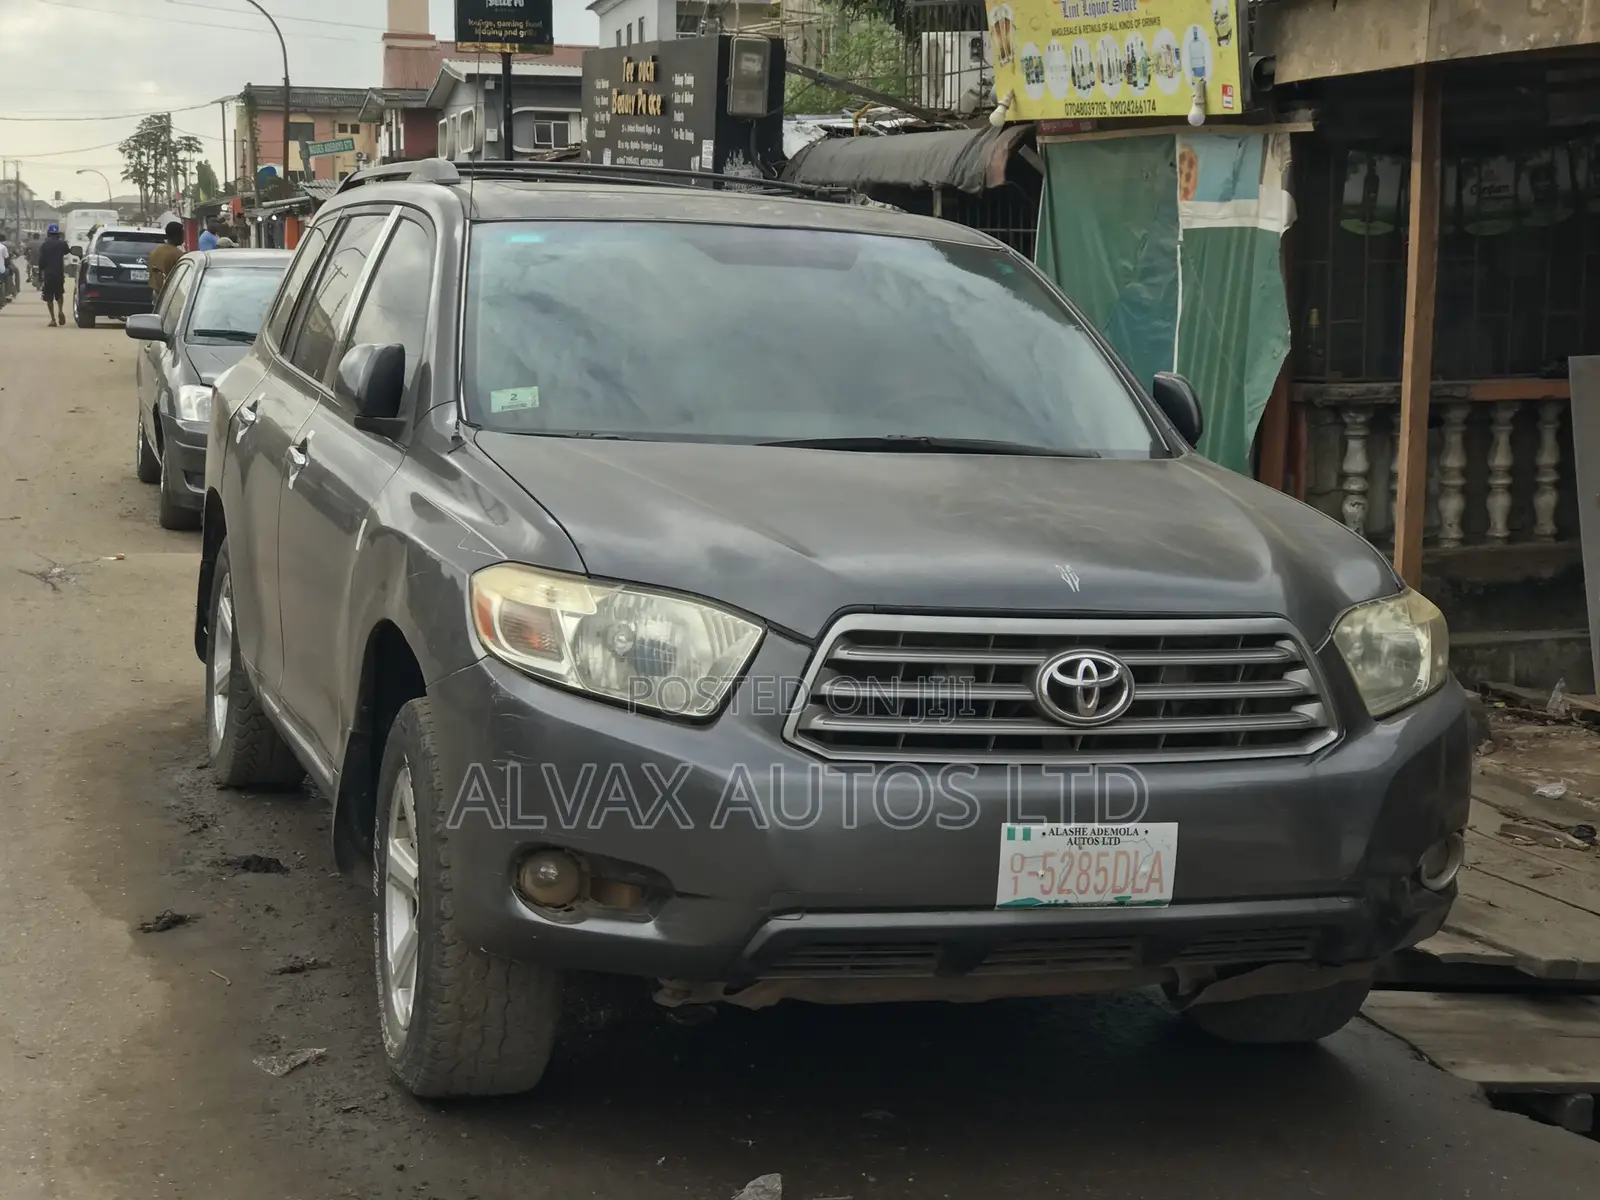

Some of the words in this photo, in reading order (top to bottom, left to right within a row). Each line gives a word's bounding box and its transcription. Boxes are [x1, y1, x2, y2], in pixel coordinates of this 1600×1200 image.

[1082, 0, 1110, 18] Liquor
[1101, 22, 1109, 32] OF
[1109, 21, 1118, 31] ALL
[1119, 19, 1133, 29] KINDS
[1134, 18, 1142, 29] OF
[1142, 16, 1161, 27] DRINKS
[1048, 827, 1087, 836] ALASHE
[1090, 827, 1139, 836] ADEMOLA
[1066, 837, 1099, 846] AUTOS
[1100, 837, 1120, 846] LTD
